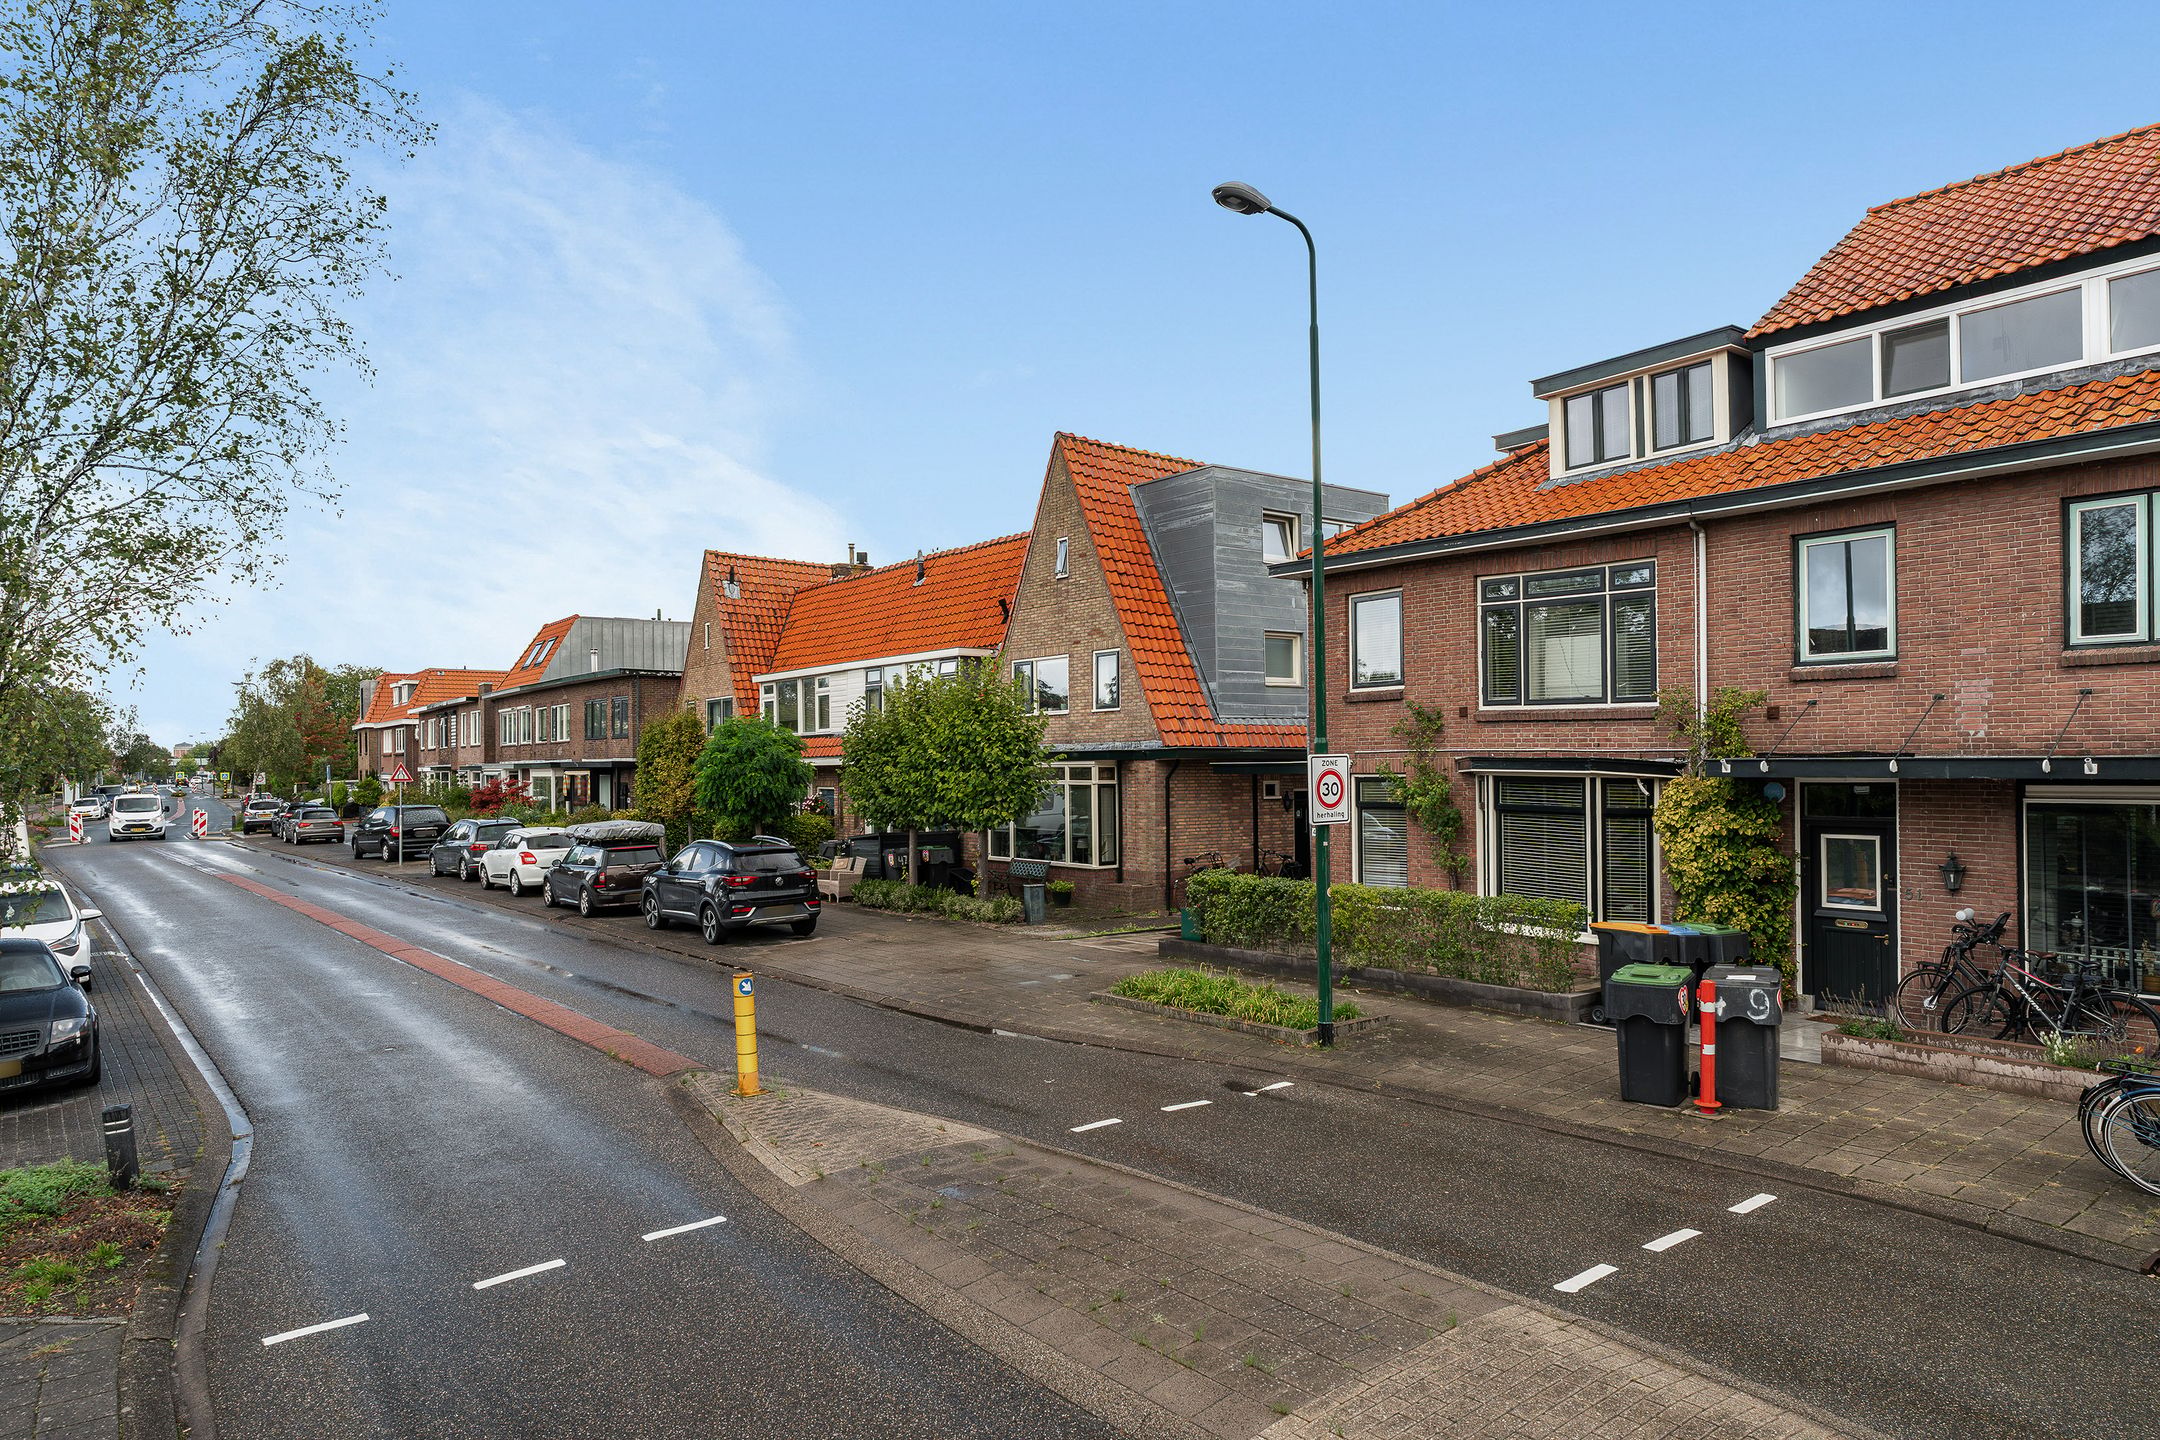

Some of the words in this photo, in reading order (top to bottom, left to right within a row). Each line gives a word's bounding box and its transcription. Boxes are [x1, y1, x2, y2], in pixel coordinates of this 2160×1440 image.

[1321, 759, 1339, 767] ZONE
[1322, 782, 1339, 796] 30
[1904, 887, 1923, 901] 51
